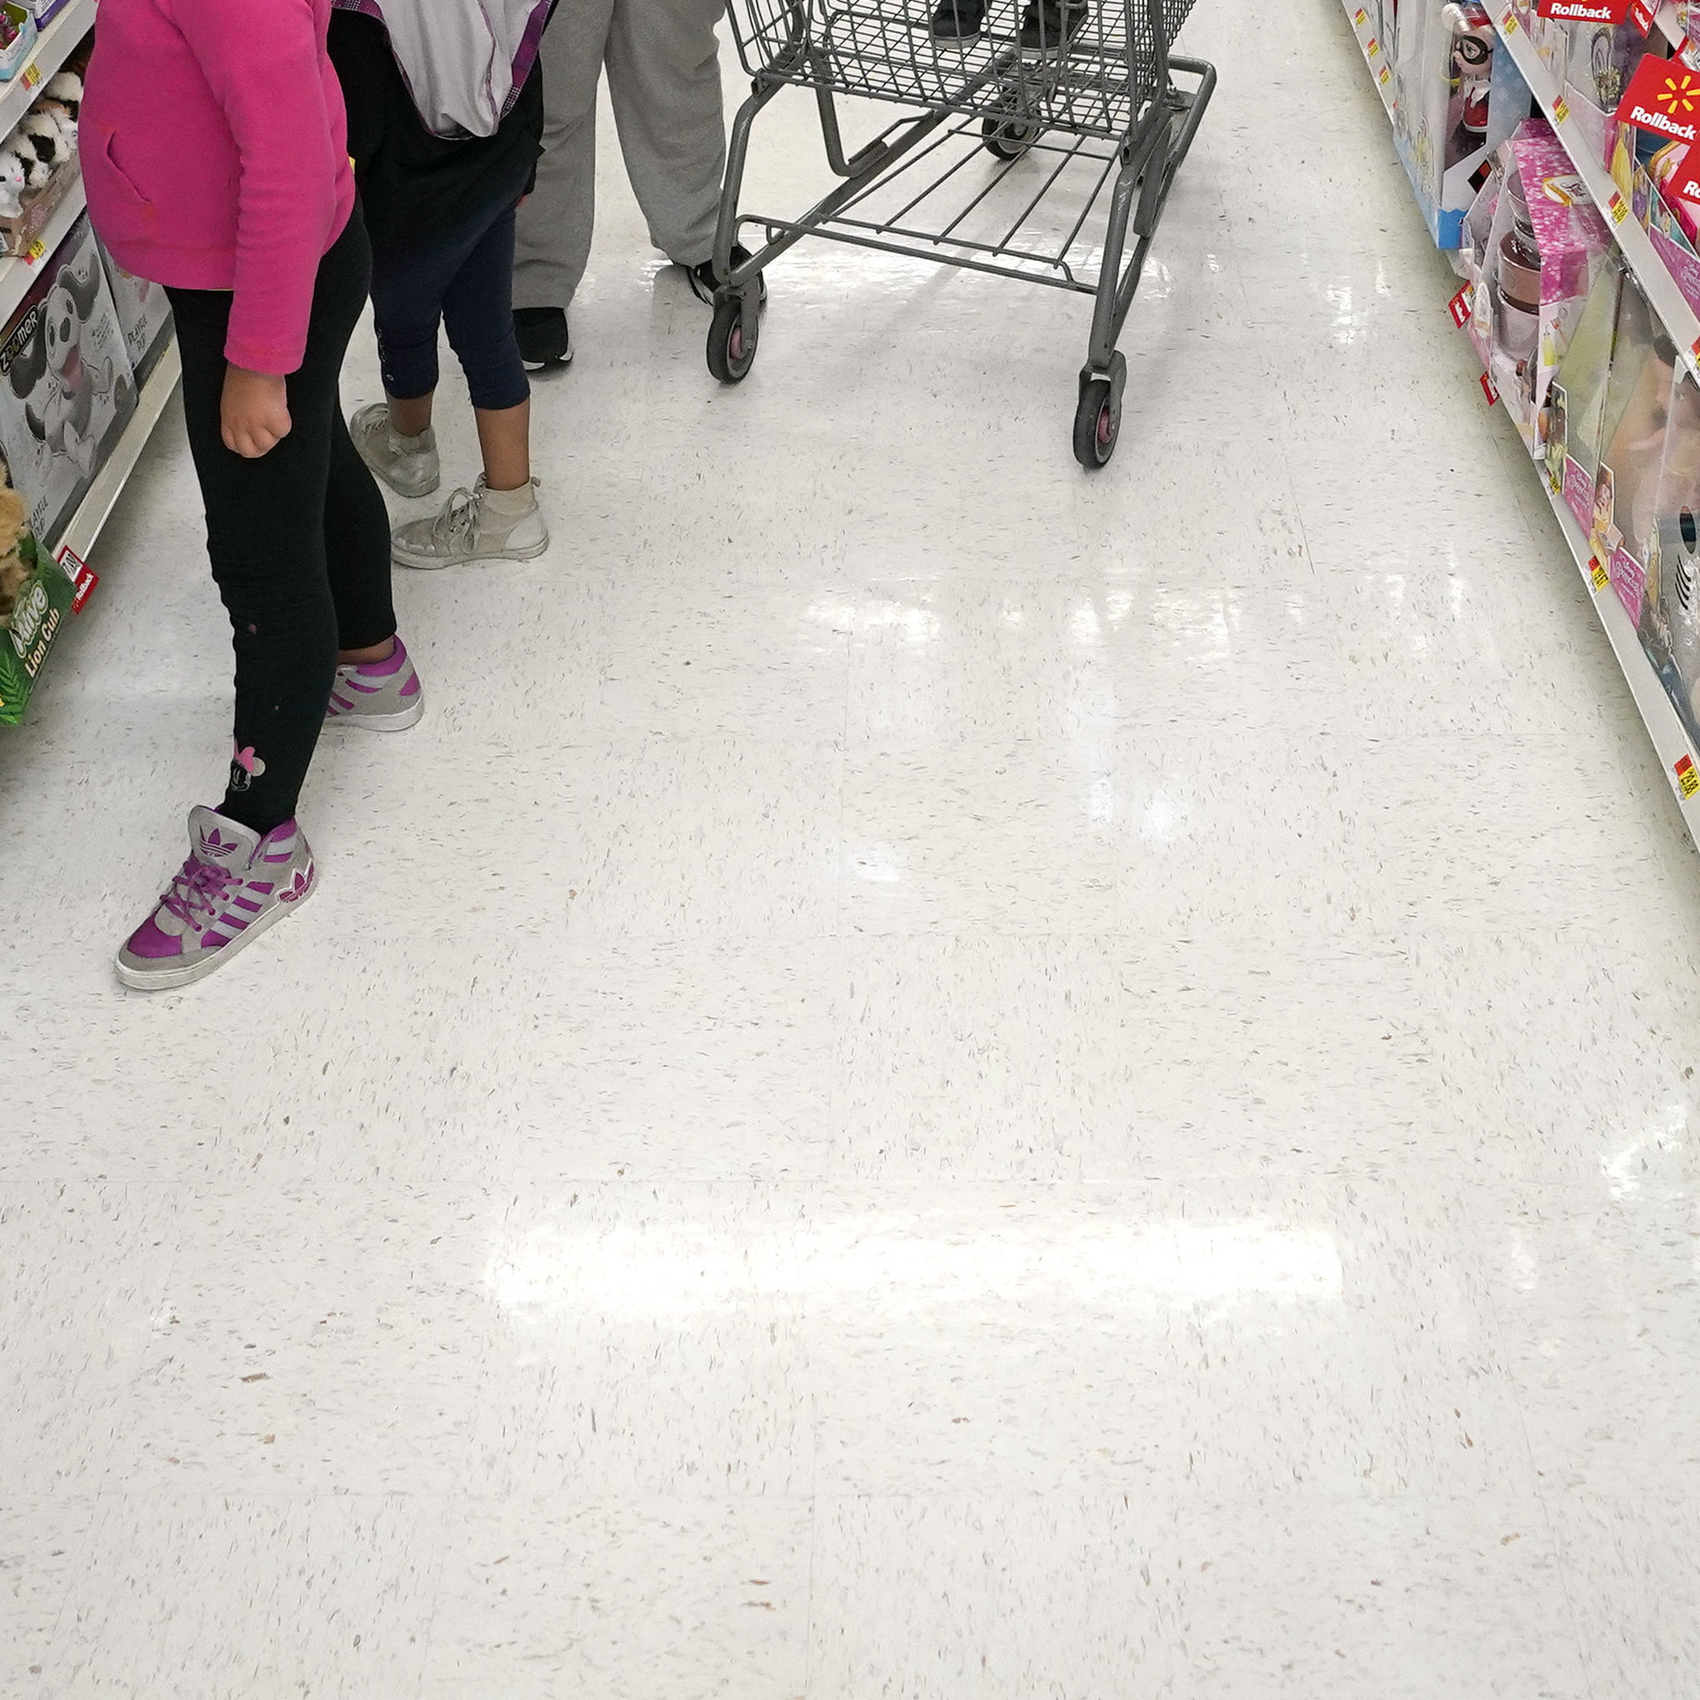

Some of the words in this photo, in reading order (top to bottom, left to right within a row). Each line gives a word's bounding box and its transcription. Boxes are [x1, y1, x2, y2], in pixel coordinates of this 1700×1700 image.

[1550, 2, 1612, 20] Rollback
[1630, 107, 1696, 140] Rollback
[23, 639, 46, 678] Lion
[39, 609, 60, 648] Cub
